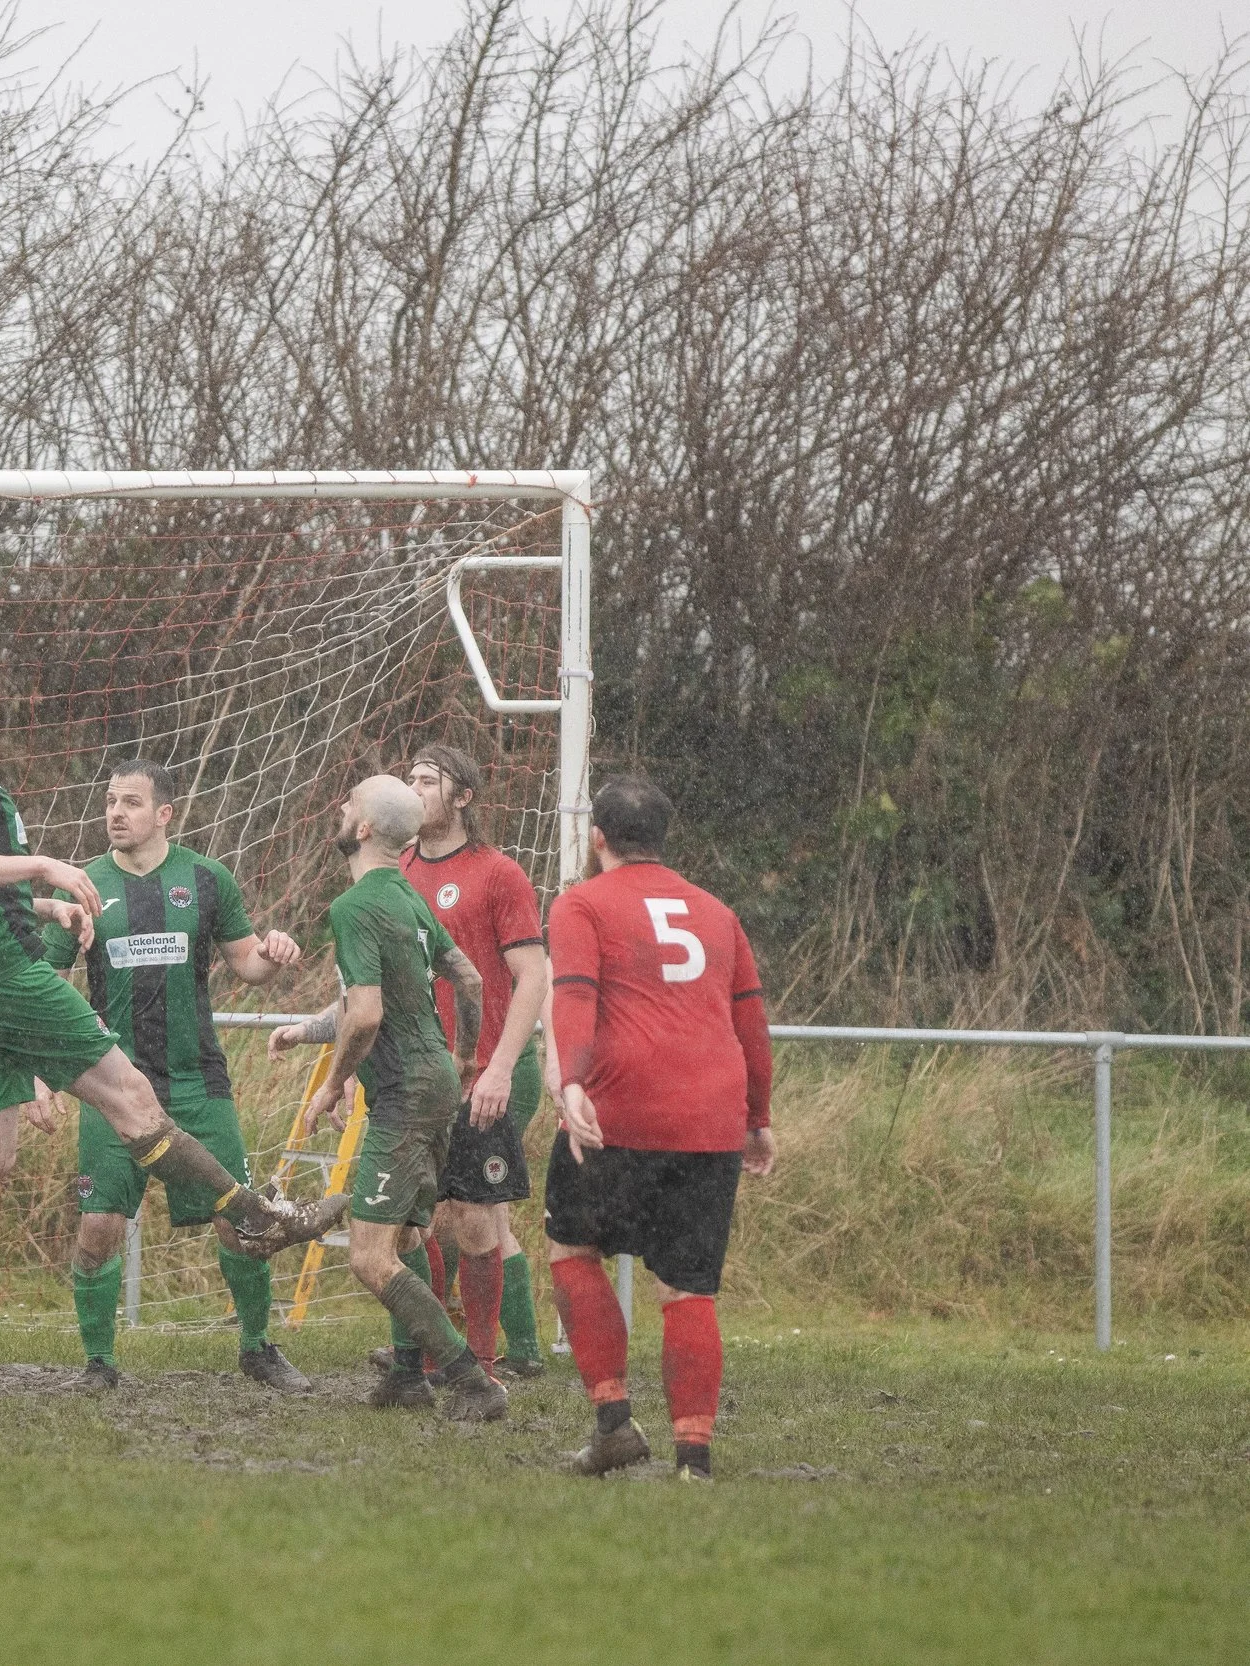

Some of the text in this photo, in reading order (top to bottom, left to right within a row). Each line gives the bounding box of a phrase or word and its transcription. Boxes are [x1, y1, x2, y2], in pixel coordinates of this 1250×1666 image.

[128, 935, 176, 947] Lakeland
[643, 898, 706, 983] 5
[129, 944, 186, 956] Verandahs
[377, 1172, 391, 1193] 7
